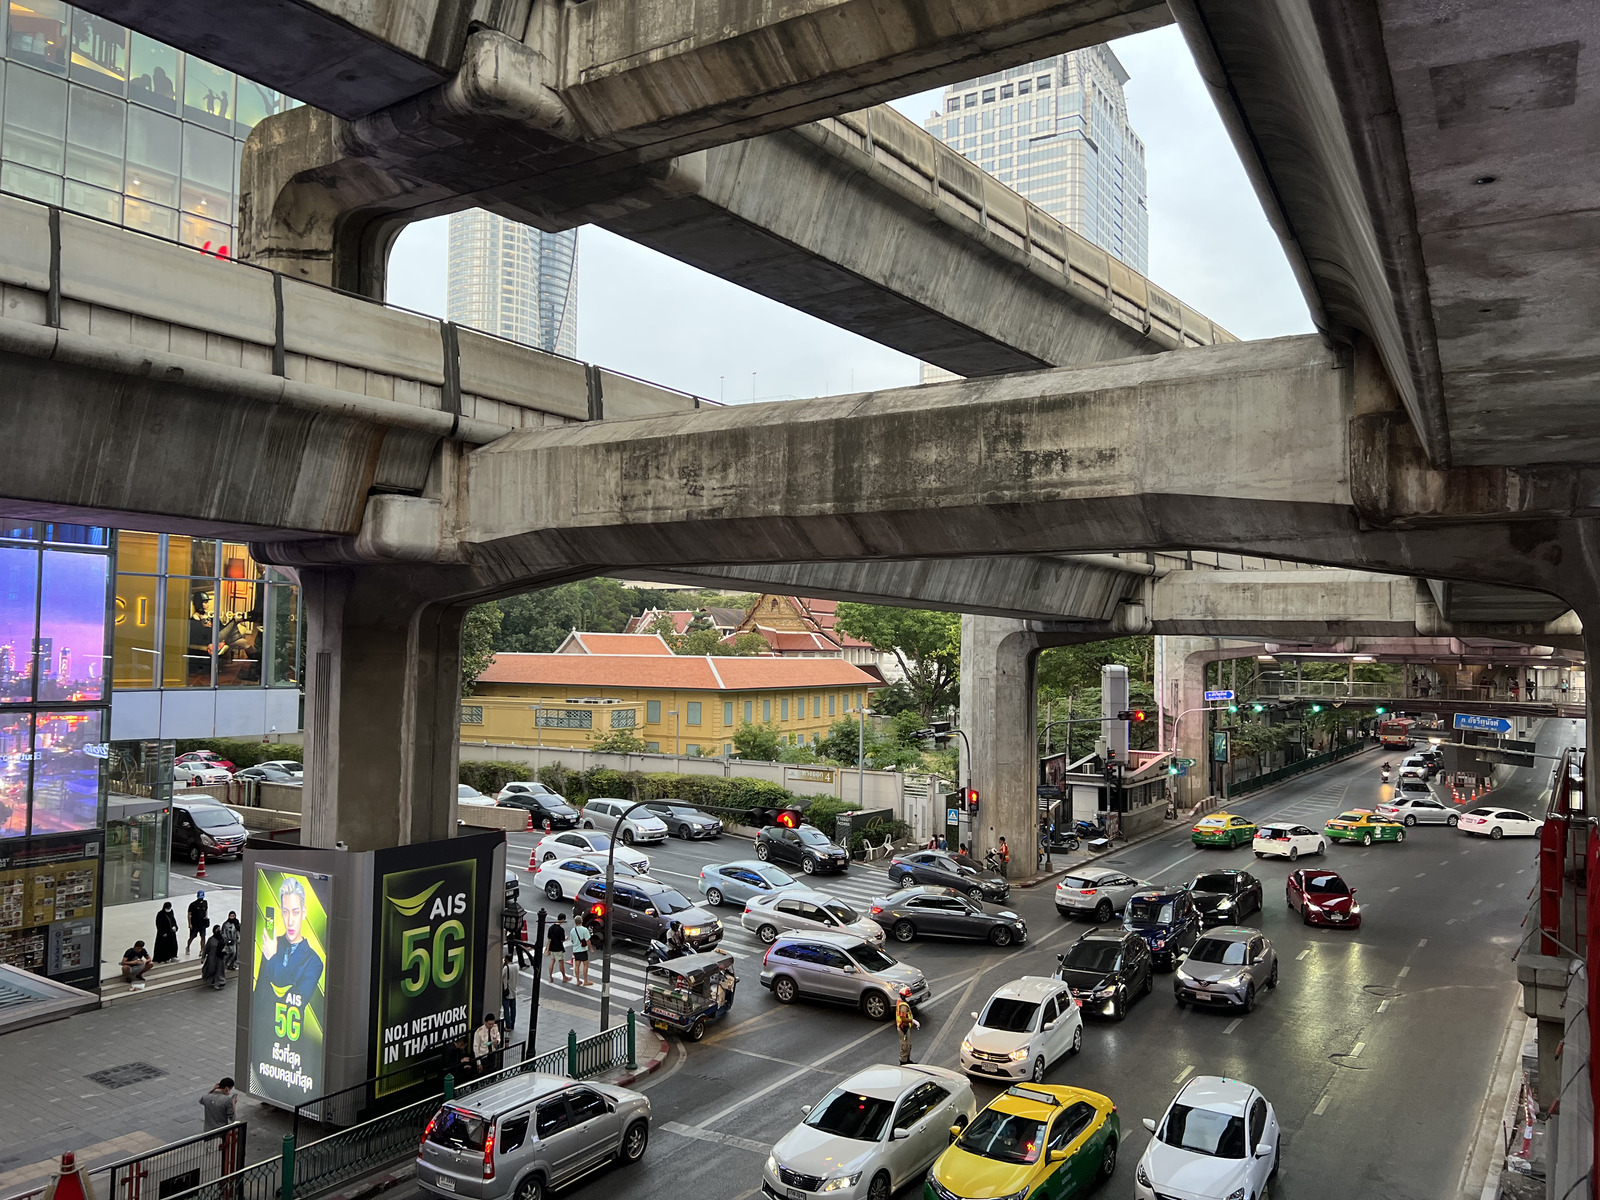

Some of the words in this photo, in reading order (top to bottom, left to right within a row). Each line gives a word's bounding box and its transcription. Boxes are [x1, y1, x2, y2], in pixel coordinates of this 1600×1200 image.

[824, 772, 831, 782] 4
[839, 836, 848, 849] 4
[429, 892, 467, 920] AIS
[400, 919, 466, 998] 5G
[285, 992, 302, 1007] AIS
[274, 1002, 301, 1042] 5G
[384, 1022, 409, 1044] NO.1
[412, 1005, 467, 1032] NETWORK
[272, 1042, 301, 1070] เร็วที่สุด
[383, 1047, 399, 1065] IN
[259, 1062, 313, 1094] ครอบคลุมที่สุด
